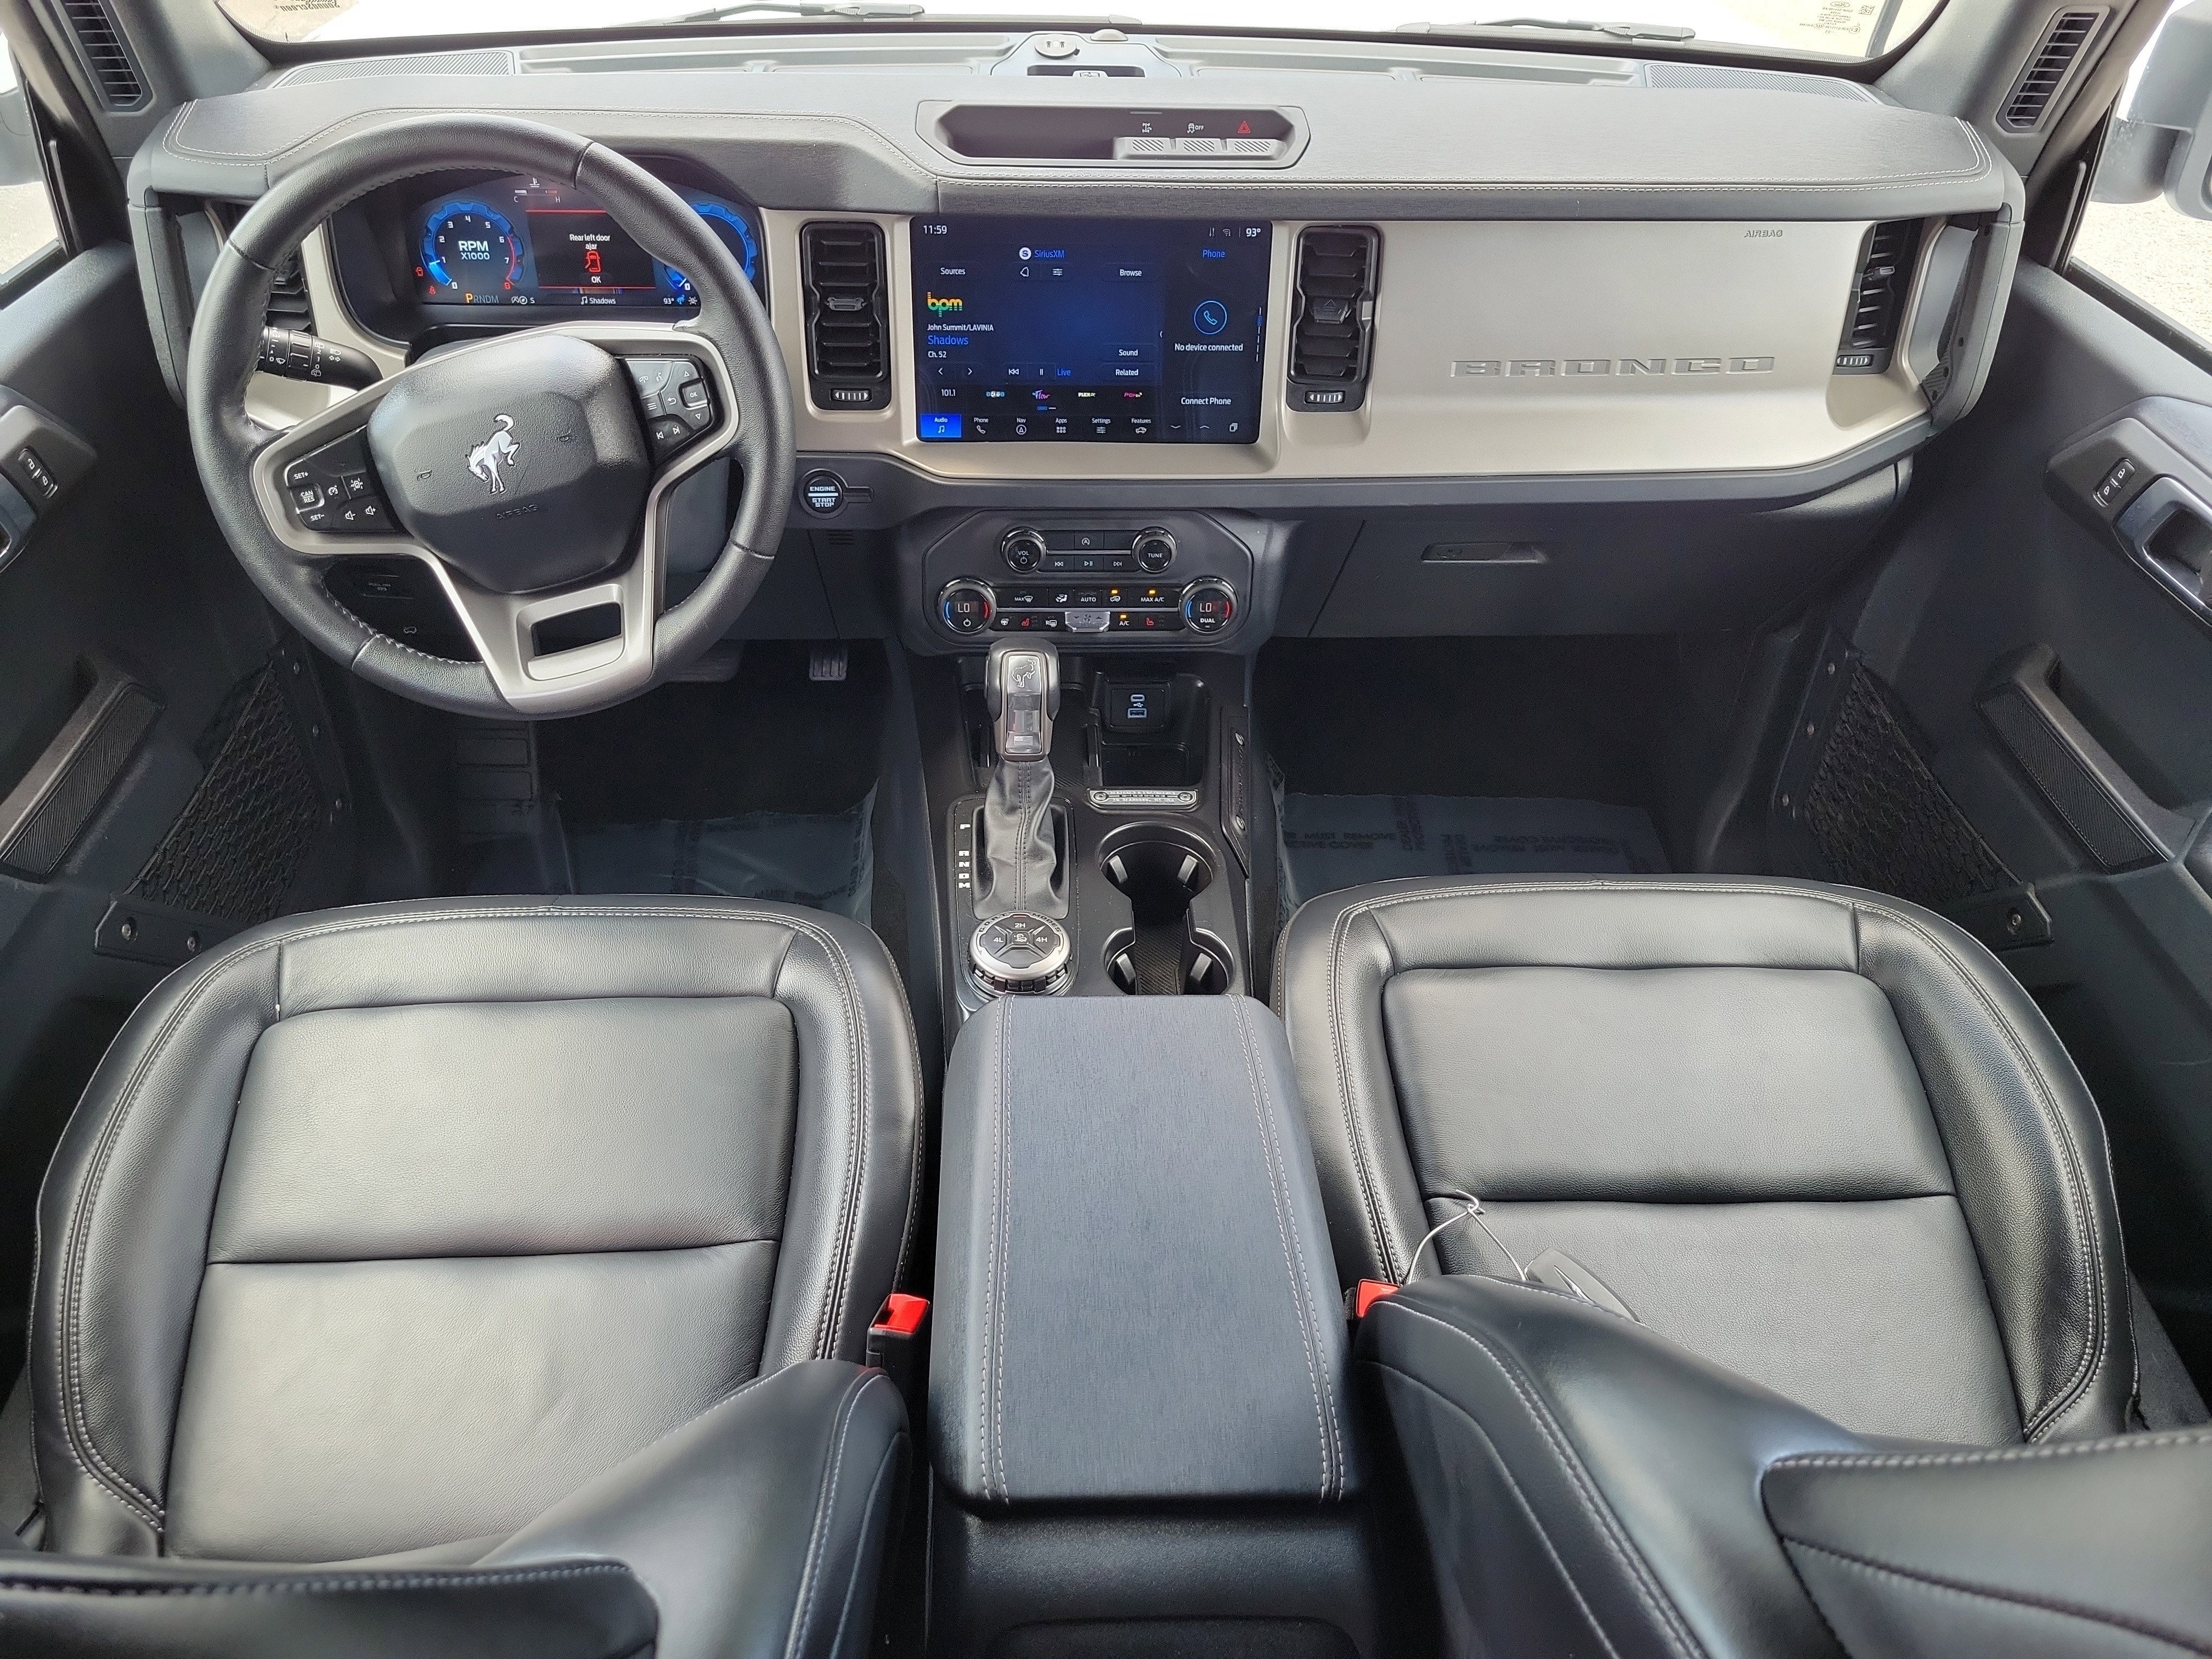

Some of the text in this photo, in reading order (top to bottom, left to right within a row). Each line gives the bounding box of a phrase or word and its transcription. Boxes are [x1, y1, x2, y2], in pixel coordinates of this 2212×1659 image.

[923, 225, 947, 234] 11:59
[458, 241, 489, 251] RPM
[461, 252, 490, 260] X1000
[1034, 250, 1065, 258] SiriusXM
[1203, 249, 1226, 258] Phone
[927, 291, 963, 318] bpm
[927, 335, 969, 345] Shadows
[1451, 357, 1775, 377] BRONCO
[1057, 368, 1071, 376] Live
[1181, 397, 1209, 405] Connect
[1032, 913, 1062, 933] MODES
